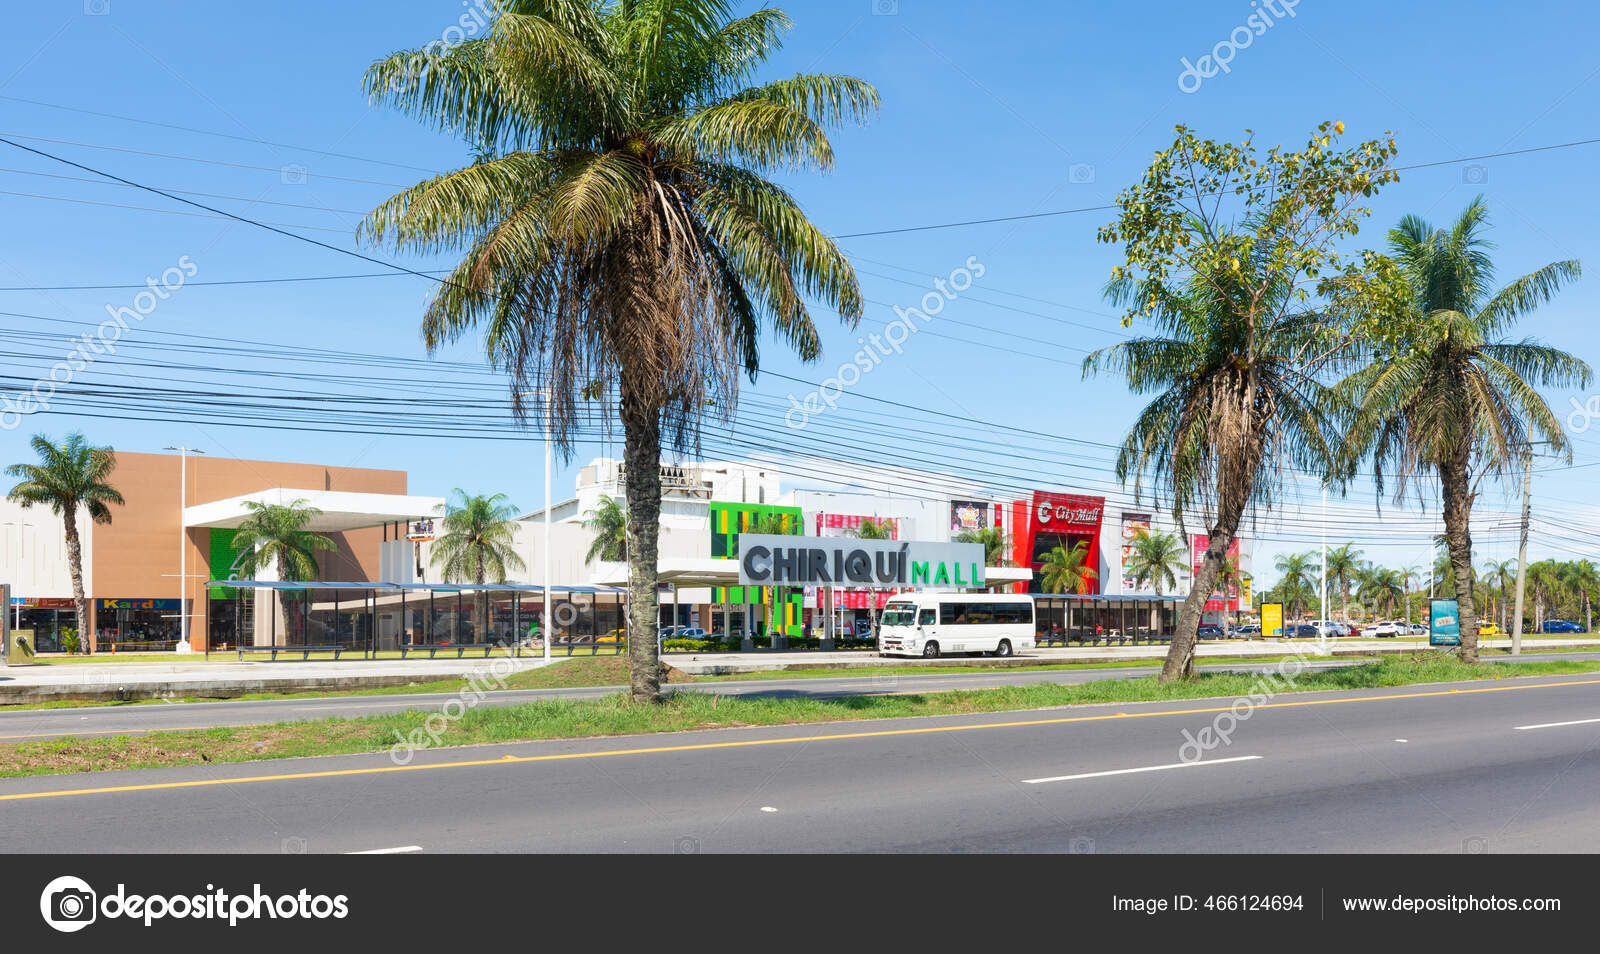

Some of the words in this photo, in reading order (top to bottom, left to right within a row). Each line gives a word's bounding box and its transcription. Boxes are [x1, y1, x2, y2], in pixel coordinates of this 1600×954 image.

[1055, 506, 1076, 524] City
[1076, 507, 1101, 522] Mall
[743, 542, 910, 584] CHIRIQUÍ
[912, 561, 985, 586] MALL
